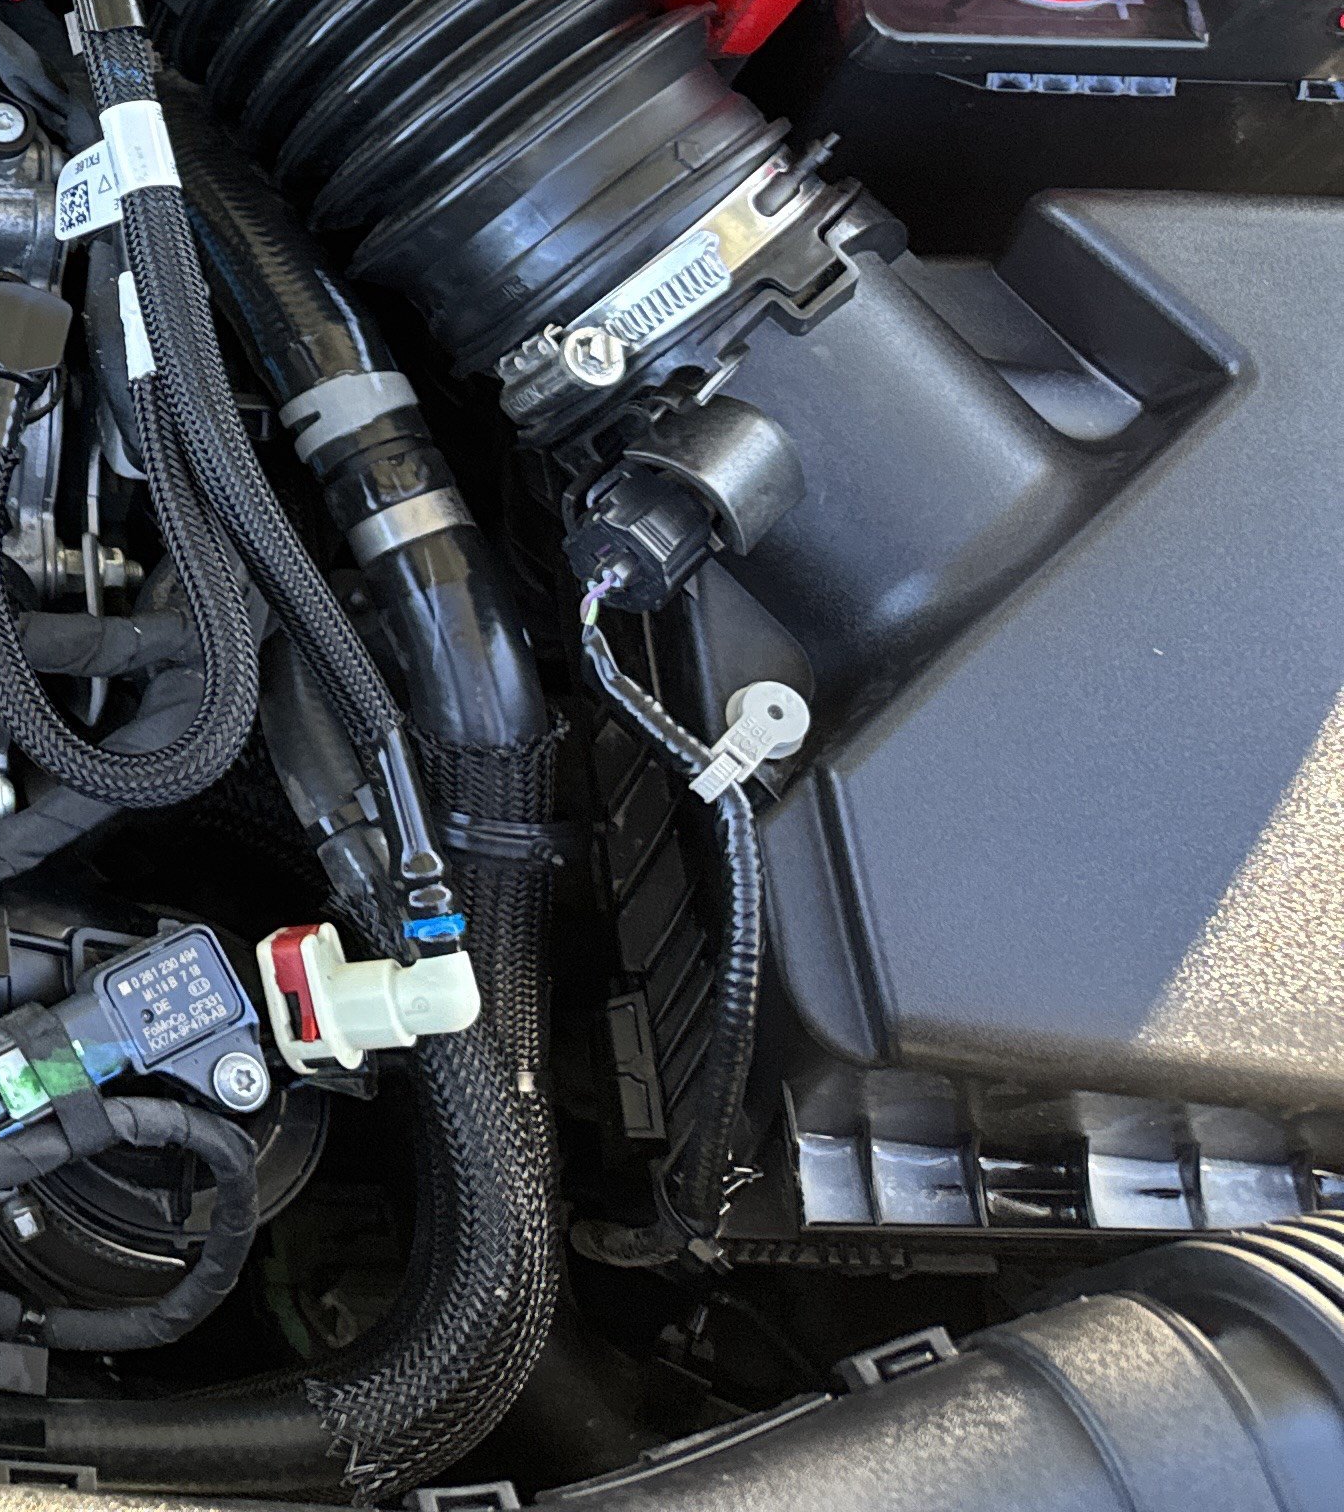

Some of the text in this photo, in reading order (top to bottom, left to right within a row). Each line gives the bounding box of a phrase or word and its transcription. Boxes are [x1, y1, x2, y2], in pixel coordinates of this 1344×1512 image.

[138, 965, 160, 986] 261
[158, 956, 179, 977] 230
[153, 997, 172, 1015] DE
[142, 1012, 187, 1039] FoMoCo
